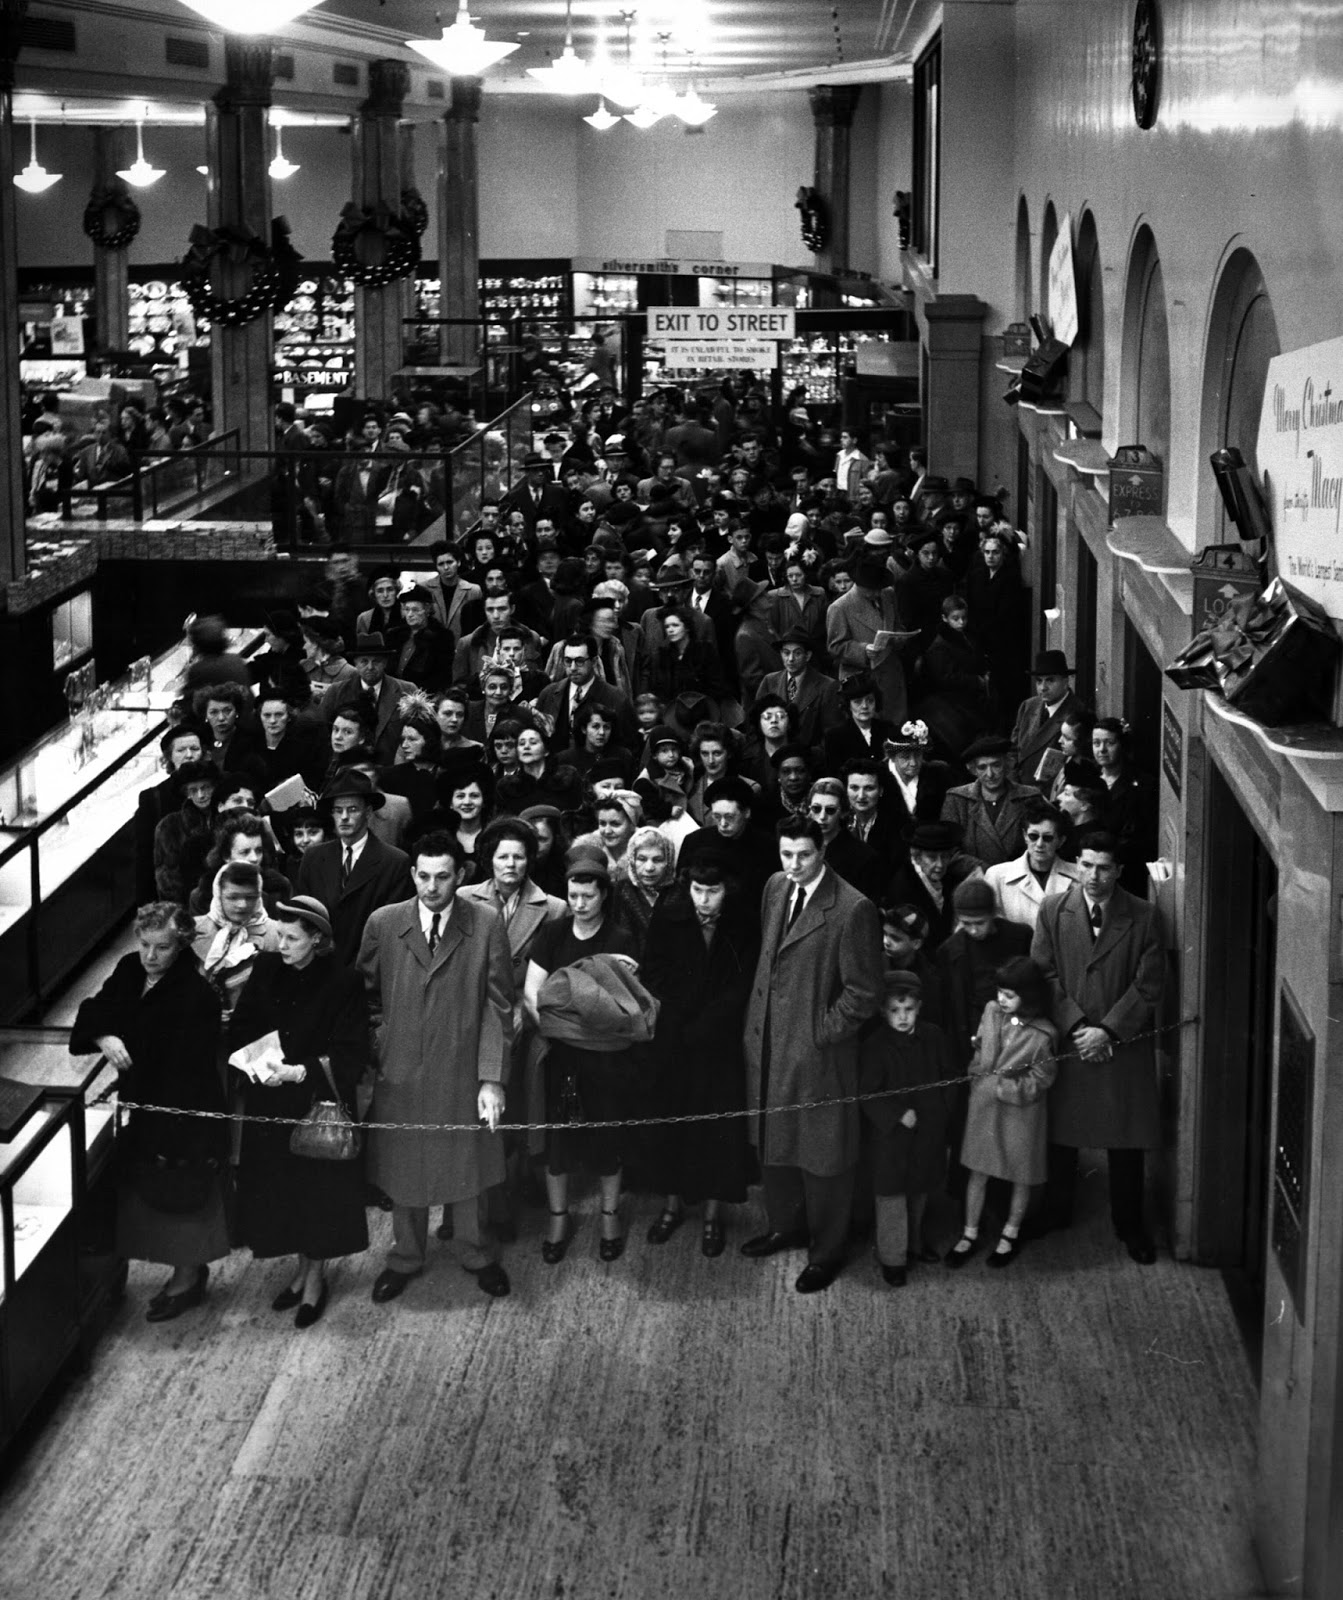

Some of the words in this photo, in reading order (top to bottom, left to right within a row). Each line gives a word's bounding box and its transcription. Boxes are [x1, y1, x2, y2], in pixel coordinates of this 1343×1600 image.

[601, 259, 679, 274] silversmith's
[692, 264, 739, 276] corner
[655, 313, 691, 332] EXIT
[697, 313, 719, 332] TO
[726, 313, 788, 332] STREET
[282, 370, 350, 385] BASEMENT
[1112, 484, 1161, 501] EXPRESS
[1222, 552, 1237, 570] 4
